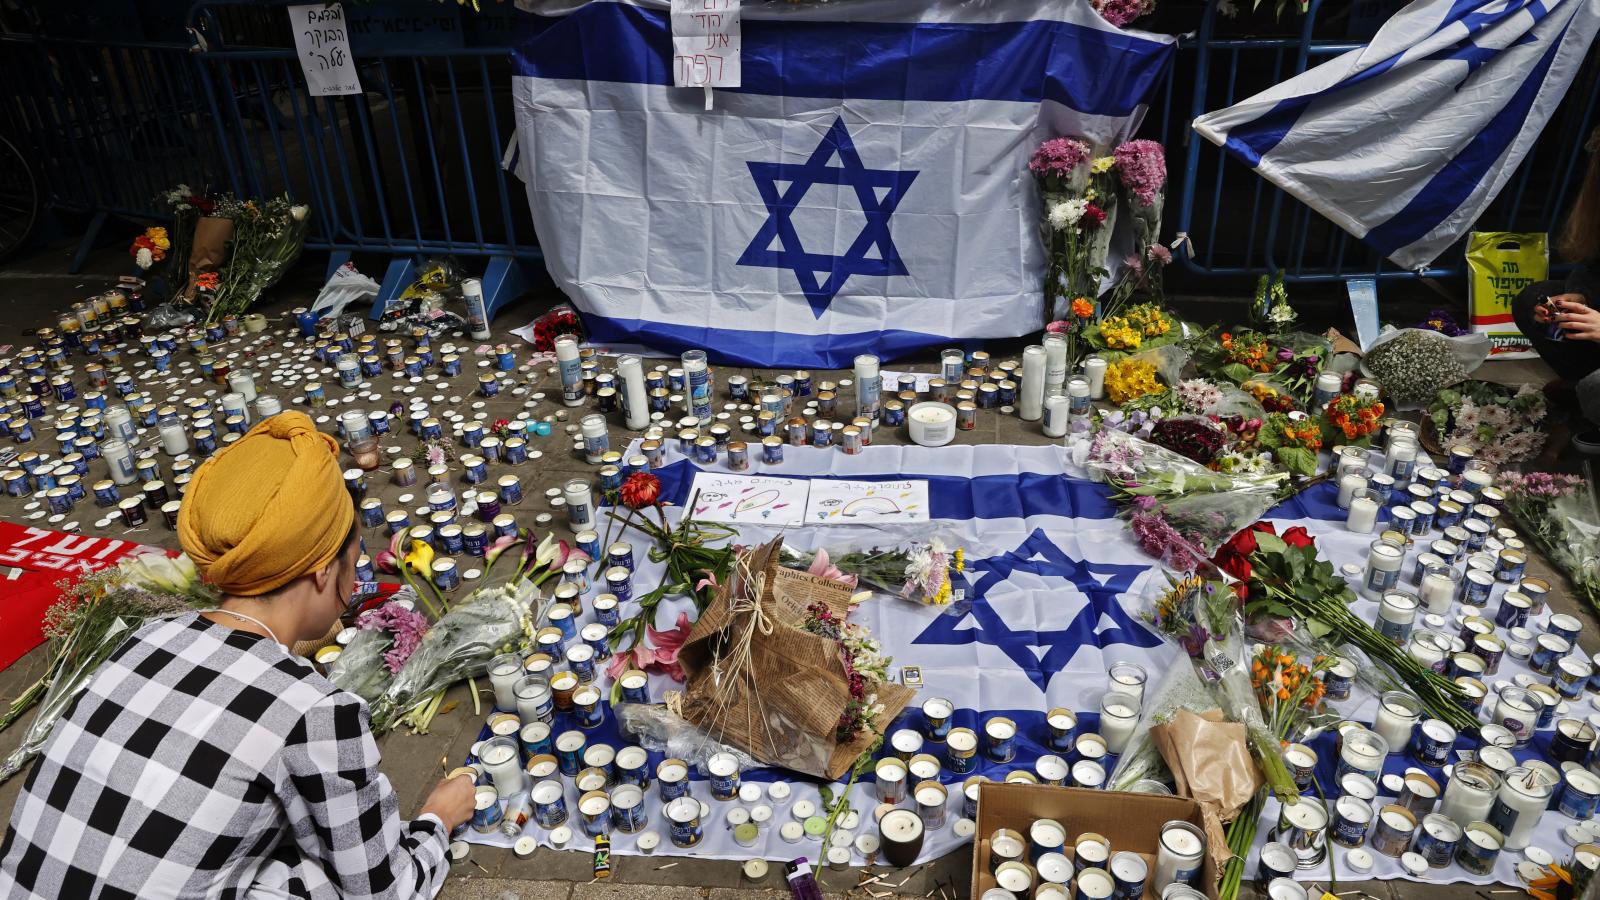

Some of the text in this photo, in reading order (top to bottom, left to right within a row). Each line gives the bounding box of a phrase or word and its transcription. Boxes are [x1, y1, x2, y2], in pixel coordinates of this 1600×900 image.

[690, 14, 724, 29] יהודי
[304, 29, 345, 48] הבוקר
[705, 32, 729, 51] אינו
[675, 54, 723, 87] הפקר
[1502, 261, 1520, 274] מה
[778, 569, 808, 581] aphics
